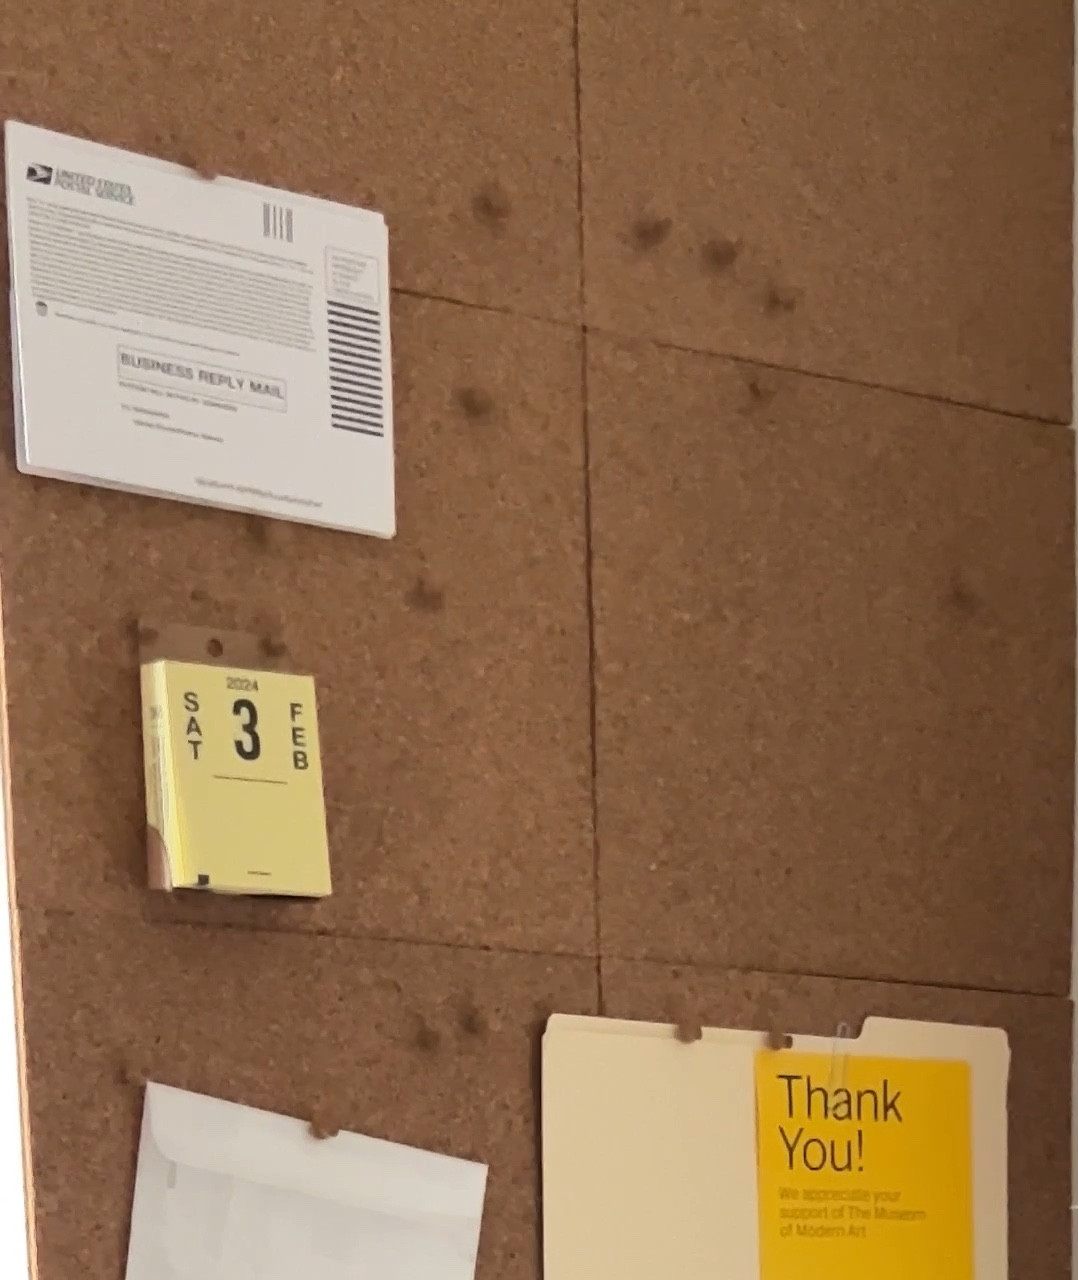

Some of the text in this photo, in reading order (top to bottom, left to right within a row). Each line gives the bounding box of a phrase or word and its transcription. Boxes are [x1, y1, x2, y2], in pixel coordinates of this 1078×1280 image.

[120, 352, 194, 380] BUSINESS
[198, 369, 246, 391] REPLY
[249, 380, 285, 400] MAIL
[226, 676, 259, 692] 2024
[232, 698, 262, 761] 3
[289, 702, 309, 770] FEB
[776, 1074, 903, 1123] Thank
[778, 1125, 864, 1172] You!
